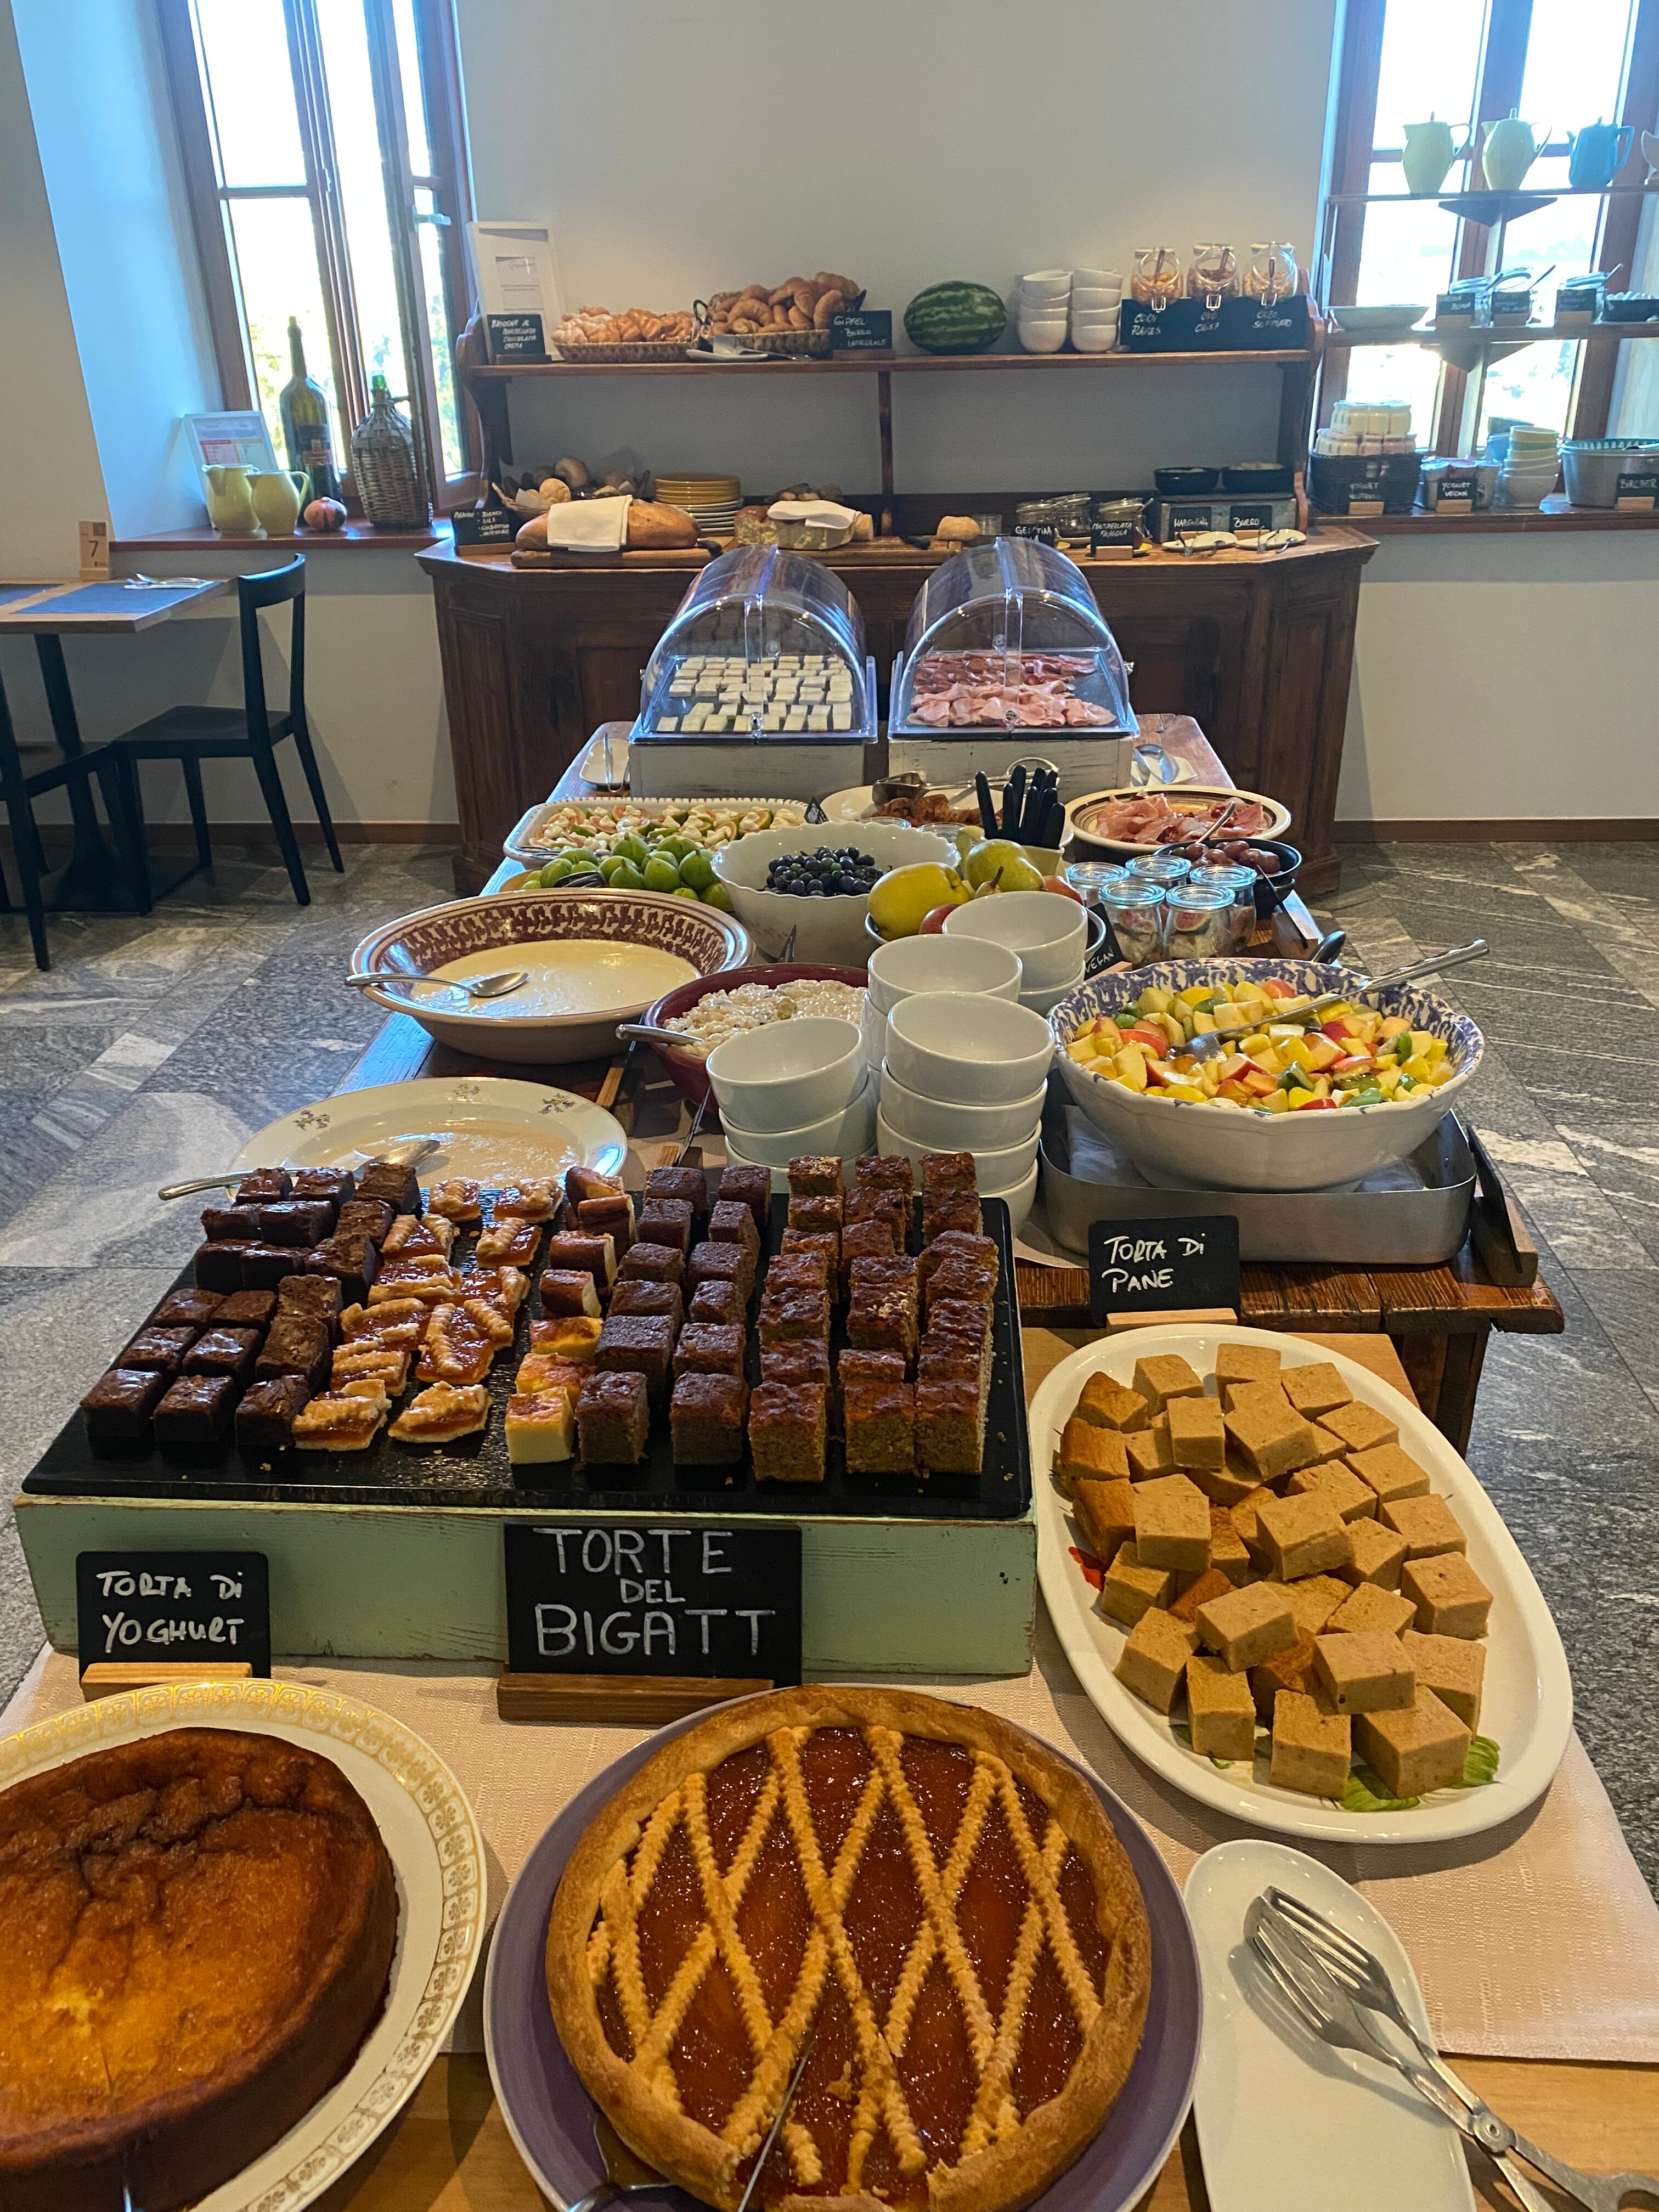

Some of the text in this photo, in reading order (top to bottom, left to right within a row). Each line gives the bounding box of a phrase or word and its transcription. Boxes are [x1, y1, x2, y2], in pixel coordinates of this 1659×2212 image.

[834, 315, 866, 325] GIPFEL
[1131, 325, 1161, 336] FLAKES
[1233, 517, 1260, 528] BURRO
[88, 540, 98, 557] 7
[1103, 1235, 1167, 1264] TORTA
[1101, 1268, 1174, 1293] PANE
[532, 1527, 733, 1574] TORTE
[96, 1571, 191, 1599] TORTA
[620, 1578, 686, 1604] DEL
[101, 1611, 245, 1654] YOGHURT
[535, 1602, 776, 1656] BIGATT
